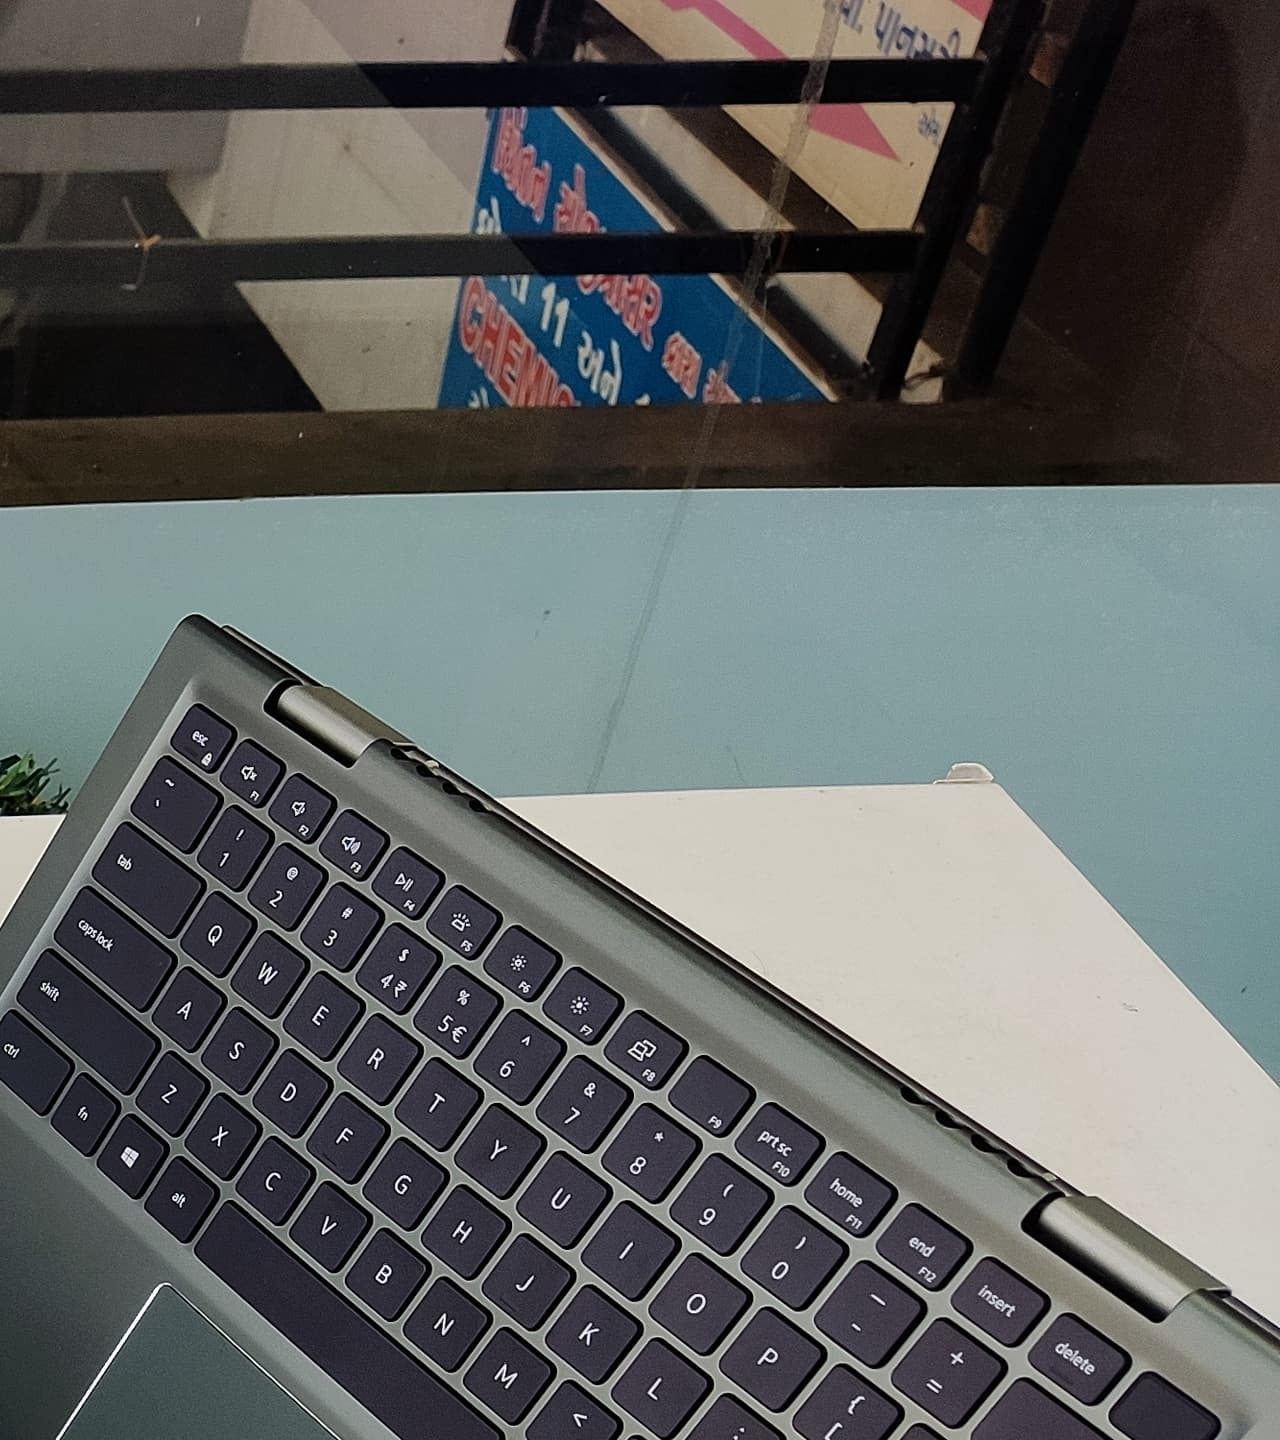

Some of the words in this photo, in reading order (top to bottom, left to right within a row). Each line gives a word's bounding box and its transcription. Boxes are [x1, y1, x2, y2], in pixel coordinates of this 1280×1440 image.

[192, 730, 209, 747] esc
[117, 854, 132, 871] tab
[78, 919, 99, 941] caps
[94, 930, 114, 952] lock
[40, 982, 60, 1002] shift
[3, 1043, 20, 1059] ctrl
[77, 1106, 88, 1121] fn
[171, 1192, 186, 1208] alt
[829, 1177, 863, 1208] home
[908, 1237, 936, 1258] end
[977, 1284, 1016, 1318] insert
[1055, 1342, 1095, 1376] delete
